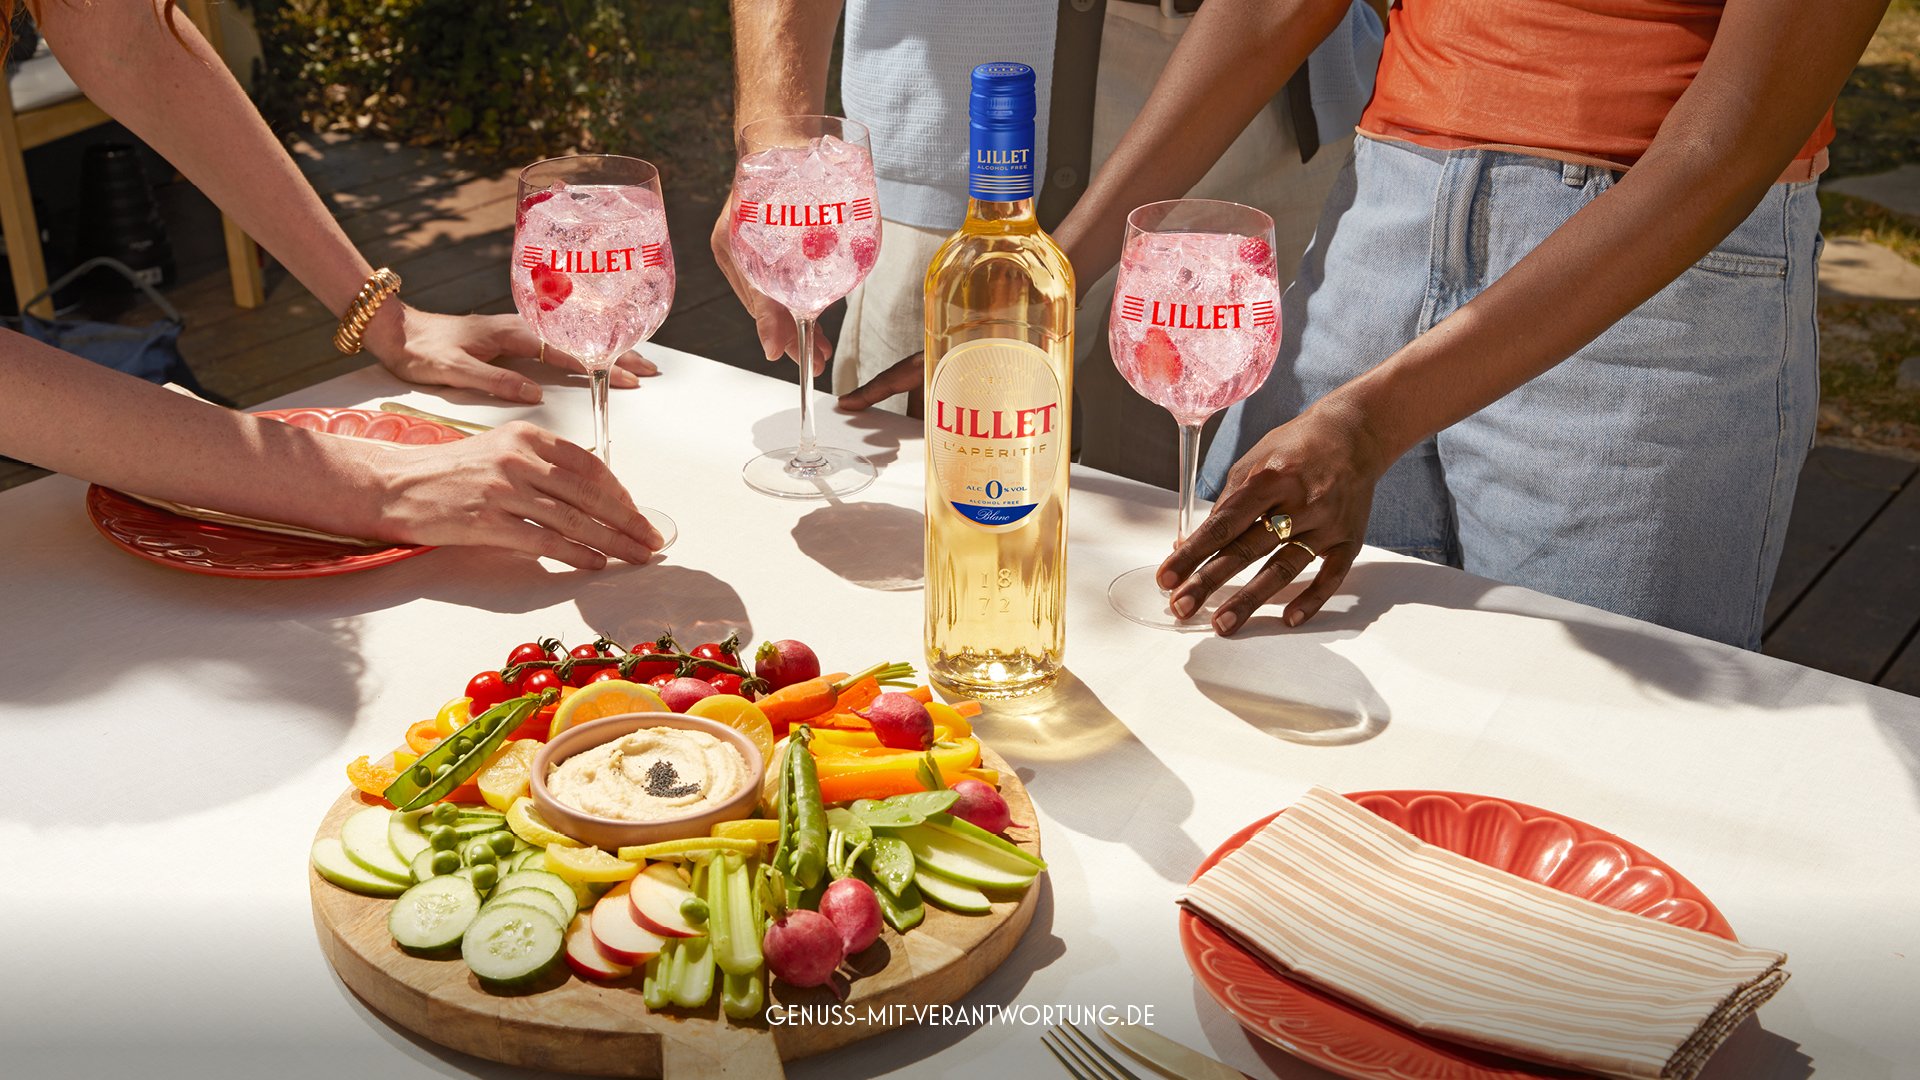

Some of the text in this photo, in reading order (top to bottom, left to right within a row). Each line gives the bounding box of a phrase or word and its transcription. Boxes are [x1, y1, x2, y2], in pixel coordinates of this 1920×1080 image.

[977, 149, 1030, 164] LILLET
[765, 202, 847, 226] LILLET
[550, 248, 636, 273] LILLET
[1151, 301, 1245, 329] LILLET
[937, 399, 1057, 439] LILLET
[944, 441, 1047, 457] L'APÉRITIF
[975, 508, 1010, 521] Blanc
